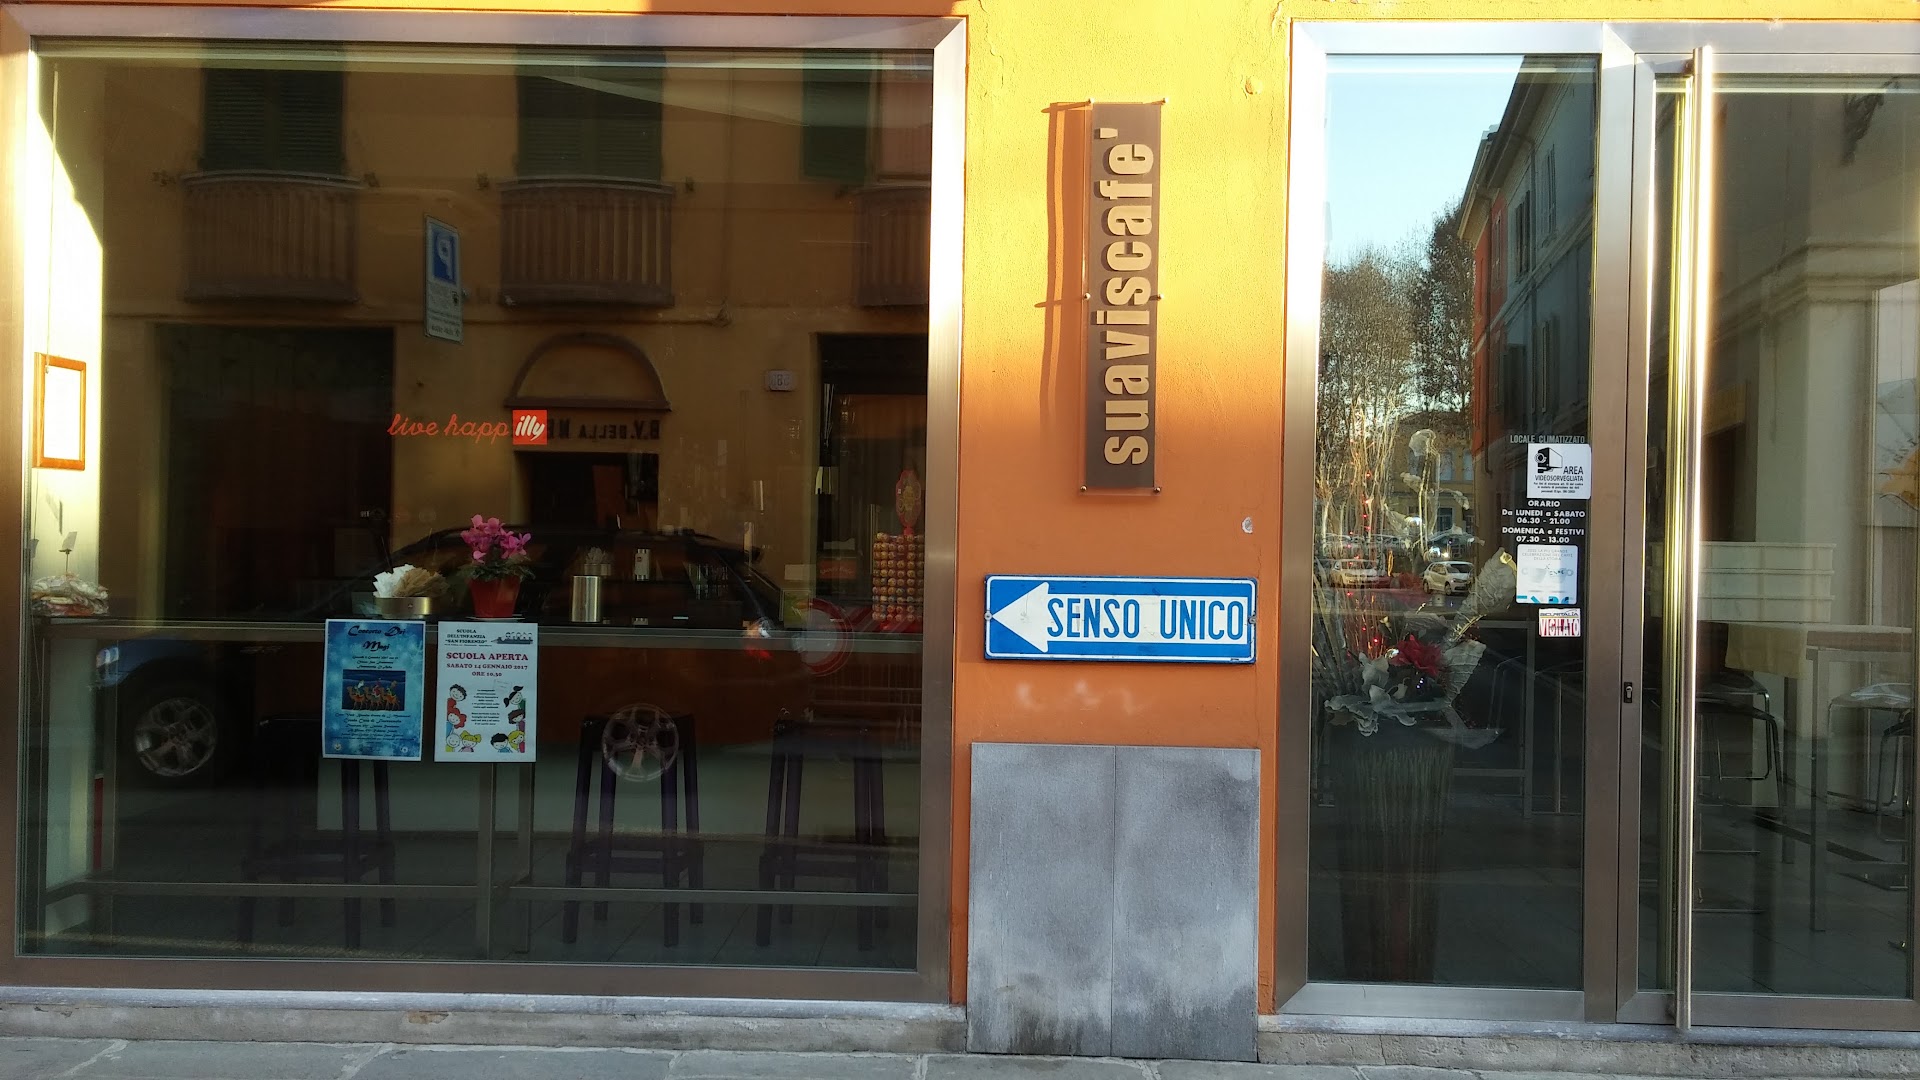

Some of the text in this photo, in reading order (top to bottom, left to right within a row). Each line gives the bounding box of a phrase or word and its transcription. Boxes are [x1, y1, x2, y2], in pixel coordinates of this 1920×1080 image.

[386, 413, 546, 444] live happ illy
[1510, 435, 1585, 444] LOCALE CLIMATIZZATO
[1563, 466, 1584, 475] AREA
[1534, 474, 1584, 482] VIDEOSORVEGLIATA
[1527, 500, 1561, 508] ORARIO
[1501, 508, 1513, 516] Da
[1515, 509, 1543, 517] LUNEDI
[1554, 510, 1585, 518] SABATO
[1502, 527, 1545, 535] DOMENICA
[1555, 528, 1585, 536] FESTIVI
[1516, 535, 1540, 543] 07.30
[1548, 536, 1570, 544] 13.00
[1047, 597, 1245, 641] SENSO UNICO
[446, 652, 529, 661] SCUOLA APERTA
